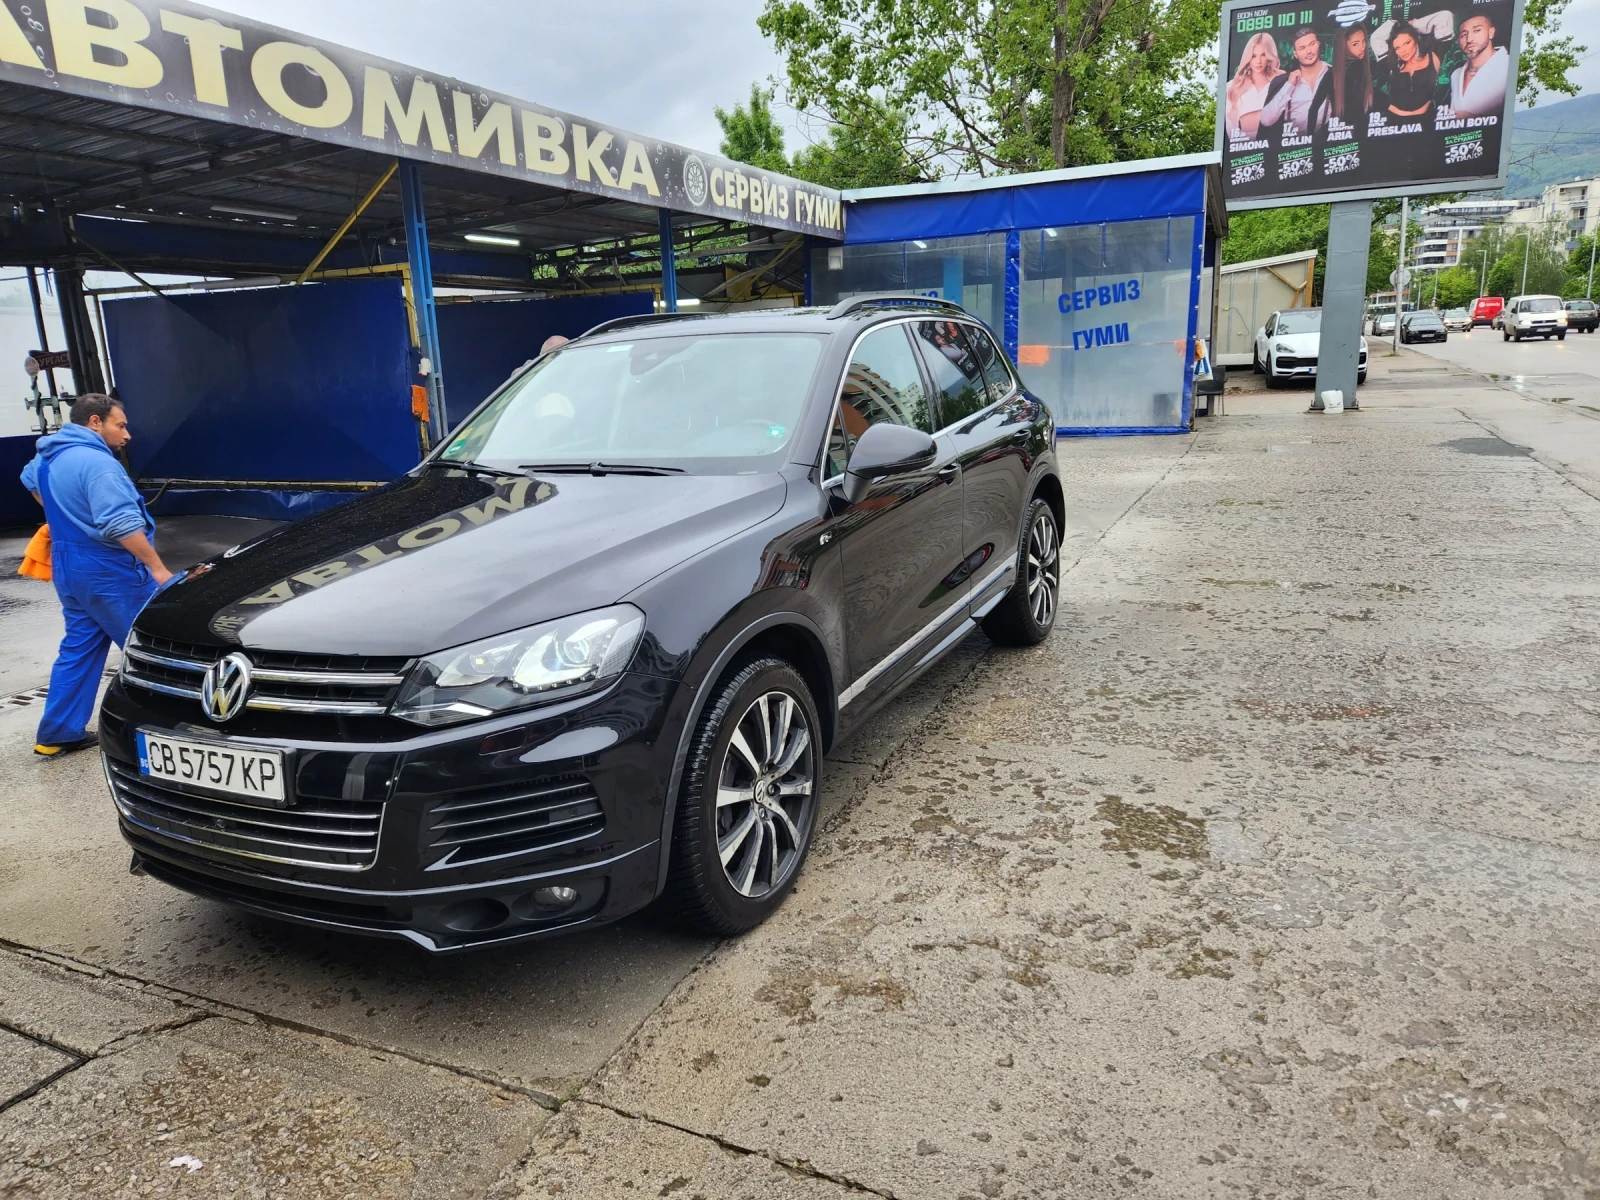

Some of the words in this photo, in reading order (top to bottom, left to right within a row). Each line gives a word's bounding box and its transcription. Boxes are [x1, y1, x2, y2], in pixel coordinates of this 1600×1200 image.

[1237, 12, 1253, 20] BOOK
[1254, 9, 1269, 18] NOW
[1237, 15, 1273, 33] 0899
[1278, 12, 1295, 27] 110
[1300, 10, 1313, 24] 111
[1367, 123, 1423, 137] PRESLAVA
[1435, 118, 1465, 130] ILIAN
[1466, 115, 1498, 128] BOYD
[1281, 135, 1312, 147] GALIN
[1327, 131, 1353, 142] ARIA
[1229, 140, 1269, 152] SIMONA
[1445, 141, 1483, 157] -50%
[1278, 158, 1313, 173] -50%
[1324, 153, 1360, 168] -50%
[1231, 164, 1265, 179] -50%
[710, 168, 789, 220] СЕРВИЗ
[795, 190, 841, 230] ГУМИ
[1058, 280, 1141, 314] СЕРВИЗ
[1073, 322, 1129, 351] ГУМИ
